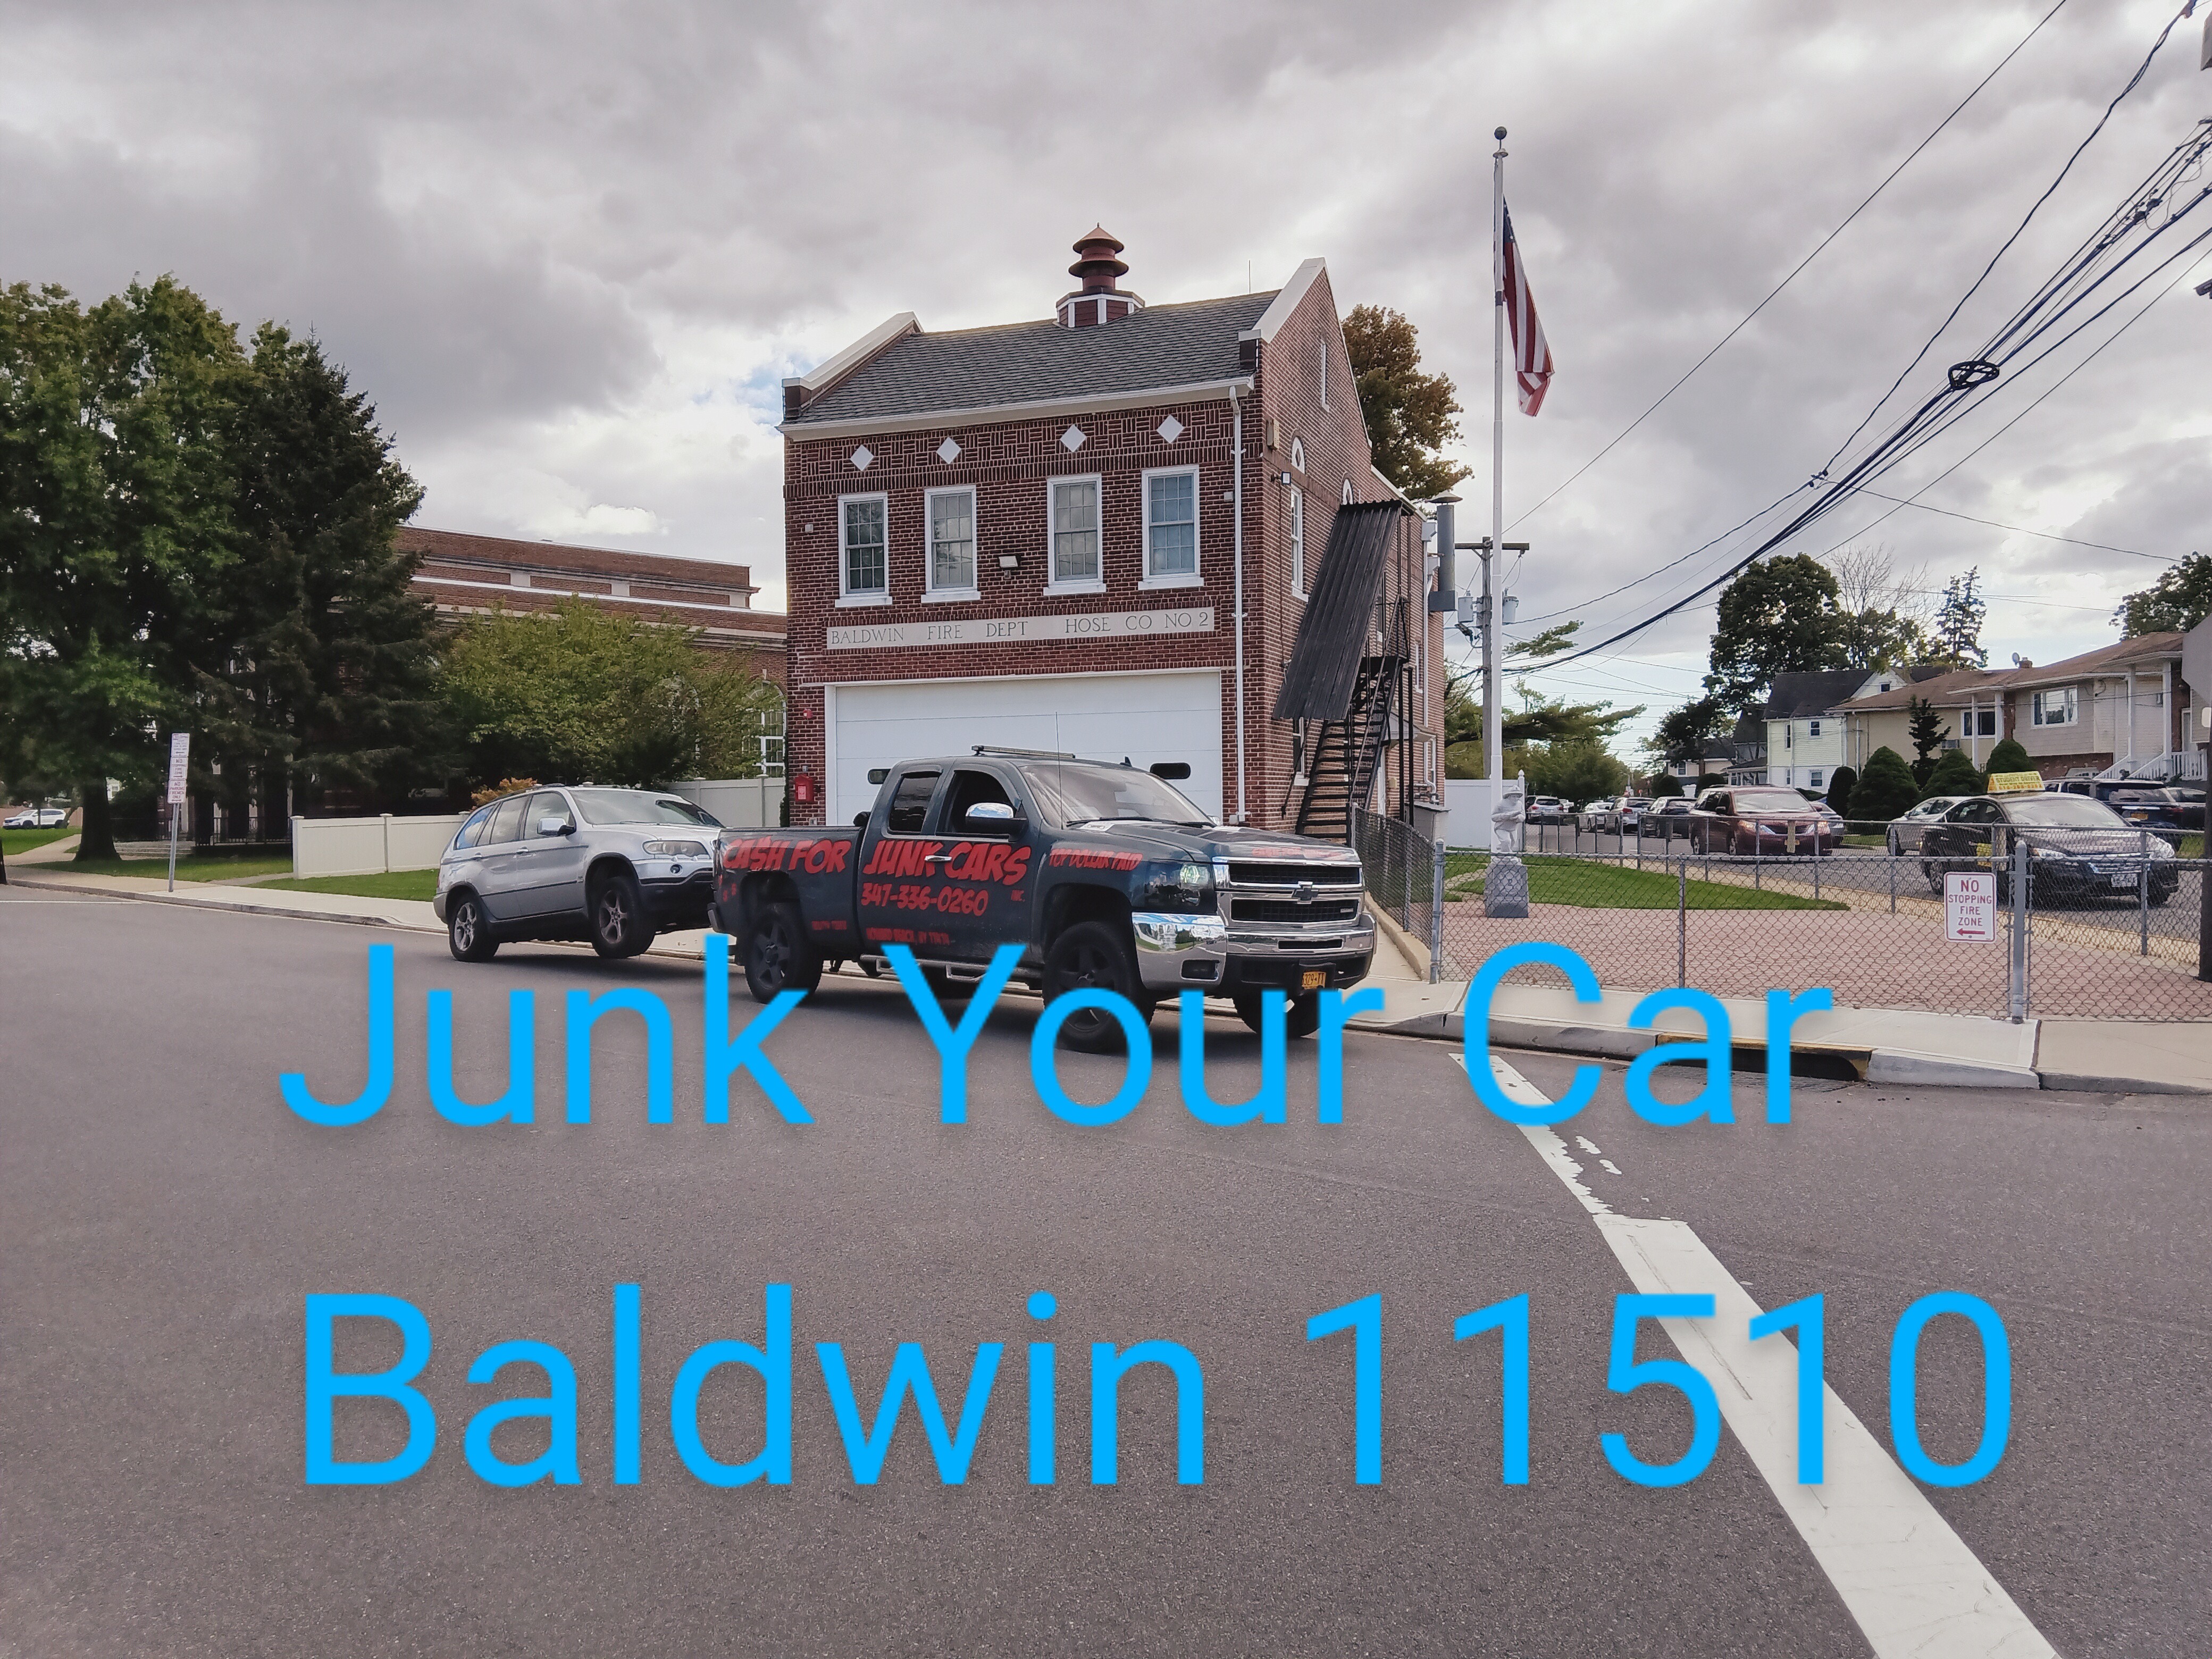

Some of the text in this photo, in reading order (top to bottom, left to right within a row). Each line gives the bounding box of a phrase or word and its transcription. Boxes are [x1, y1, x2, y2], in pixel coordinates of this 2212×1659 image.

[831, 611, 1208, 644] BALDWIN FIRE DEPT HOSE CO NO 2
[789, 840, 852, 874] FOR
[862, 840, 944, 877] JUNK
[944, 842, 1031, 885] CARS
[1049, 849, 1143, 870] TOP DOLLAR PAID
[1960, 879, 1979, 893] NO
[861, 882, 988, 916] 347-336-0260
[1948, 894, 1992, 904] STOPPING
[1960, 906, 1981, 915] FIRE
[1958, 917, 1983, 926] ZONE
